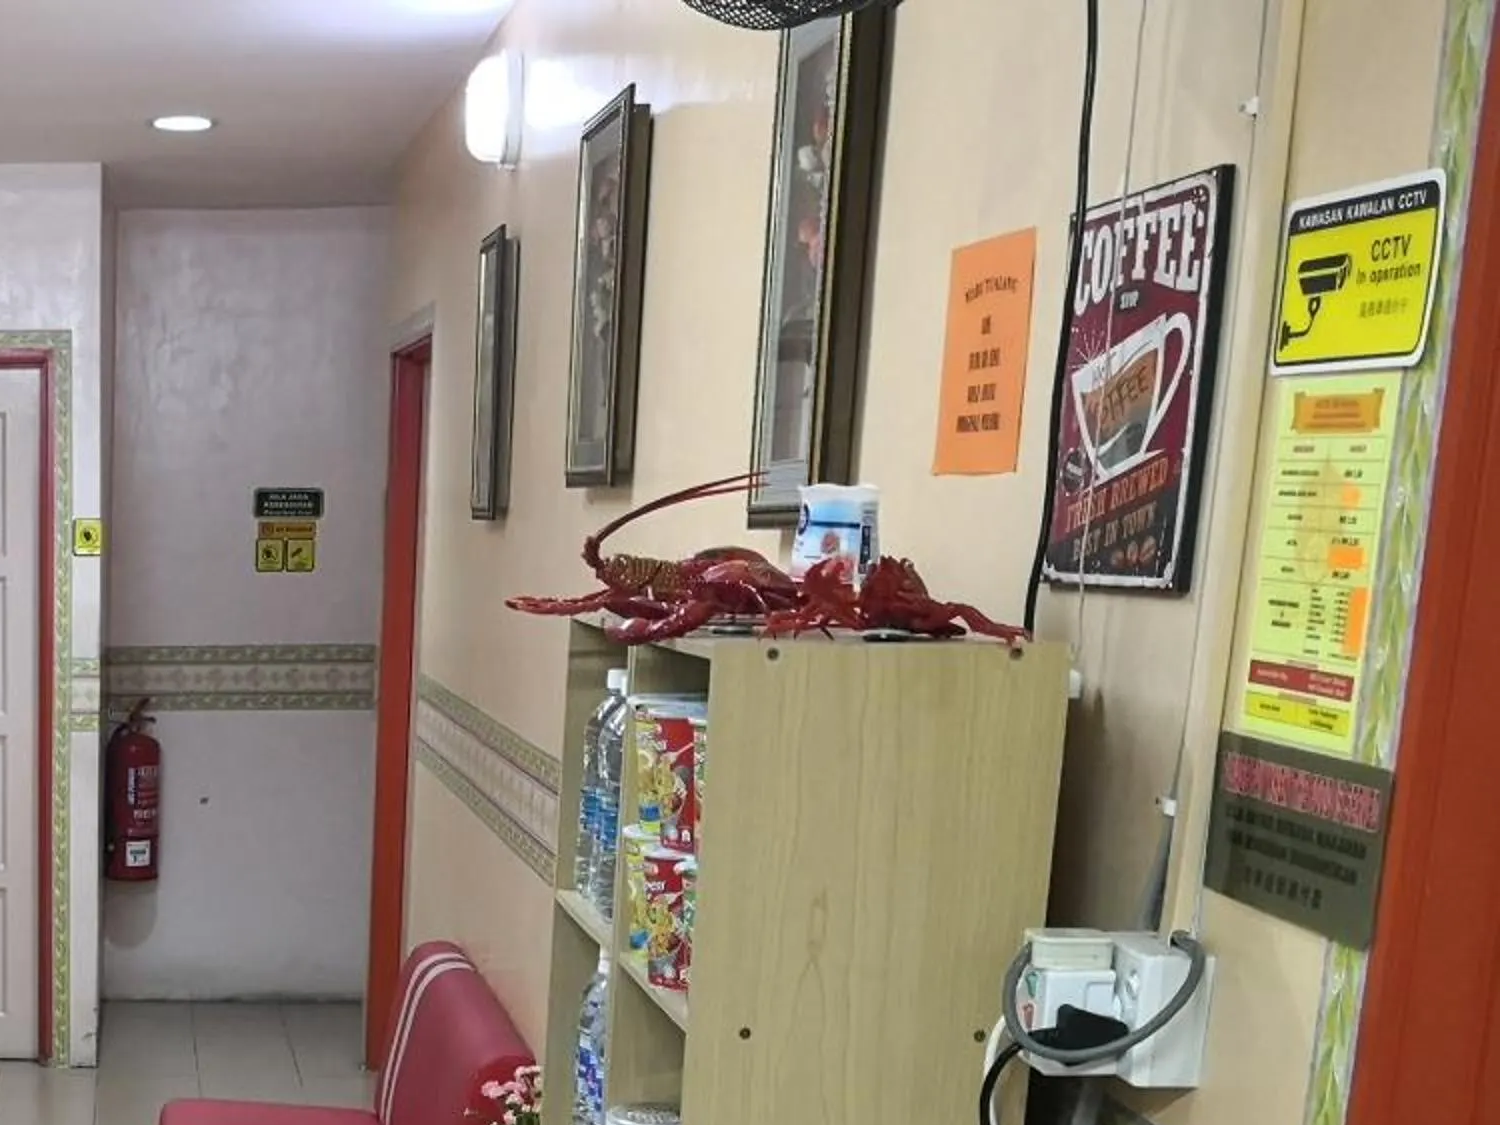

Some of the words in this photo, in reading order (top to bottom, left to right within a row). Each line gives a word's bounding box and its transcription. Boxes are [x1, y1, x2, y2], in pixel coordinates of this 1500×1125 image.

[1298, 207, 1344, 229] KAWASAN
[1346, 196, 1396, 221] KAWALAN
[1397, 188, 1428, 210] CCTV
[1073, 200, 1204, 317] COFFEE
[1371, 233, 1412, 262] CCTV
[1369, 263, 1421, 288] operation
